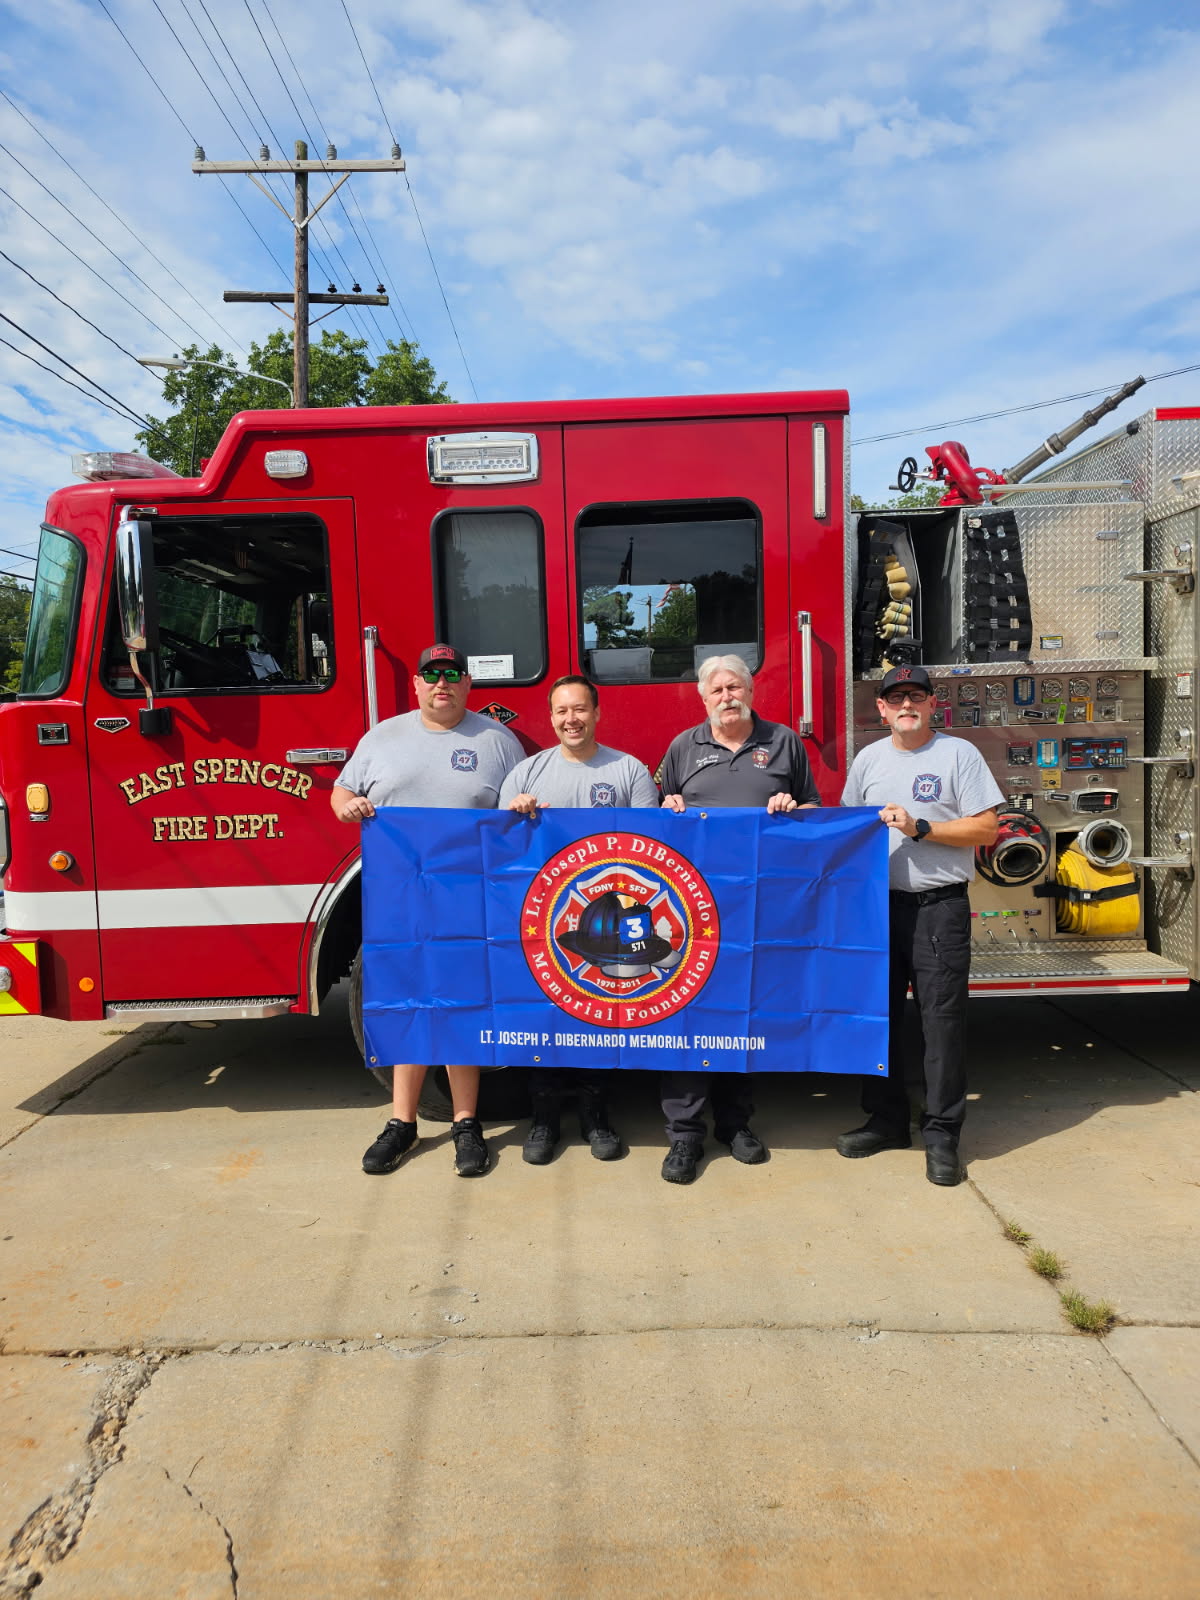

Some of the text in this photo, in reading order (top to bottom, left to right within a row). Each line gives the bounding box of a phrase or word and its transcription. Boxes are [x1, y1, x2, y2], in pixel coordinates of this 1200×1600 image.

[458, 756, 470, 764] 47
[119, 758, 313, 805] EAST SPENCER
[919, 783, 932, 793] 47
[598, 791, 609, 800] 47
[153, 813, 284, 841] FIRE DEPT.
[525, 836, 712, 922] Lt. Joseph P. DiBernardo
[588, 882, 648, 895] FDNY SFD
[626, 918, 644, 939] 3
[631, 940, 646, 952] 571
[532, 950, 710, 1022] Memorial Foundation
[480, 1030, 765, 1050] LT. JOSEPH P. DIBERNARDO MEMORIAL FOUNDATION
